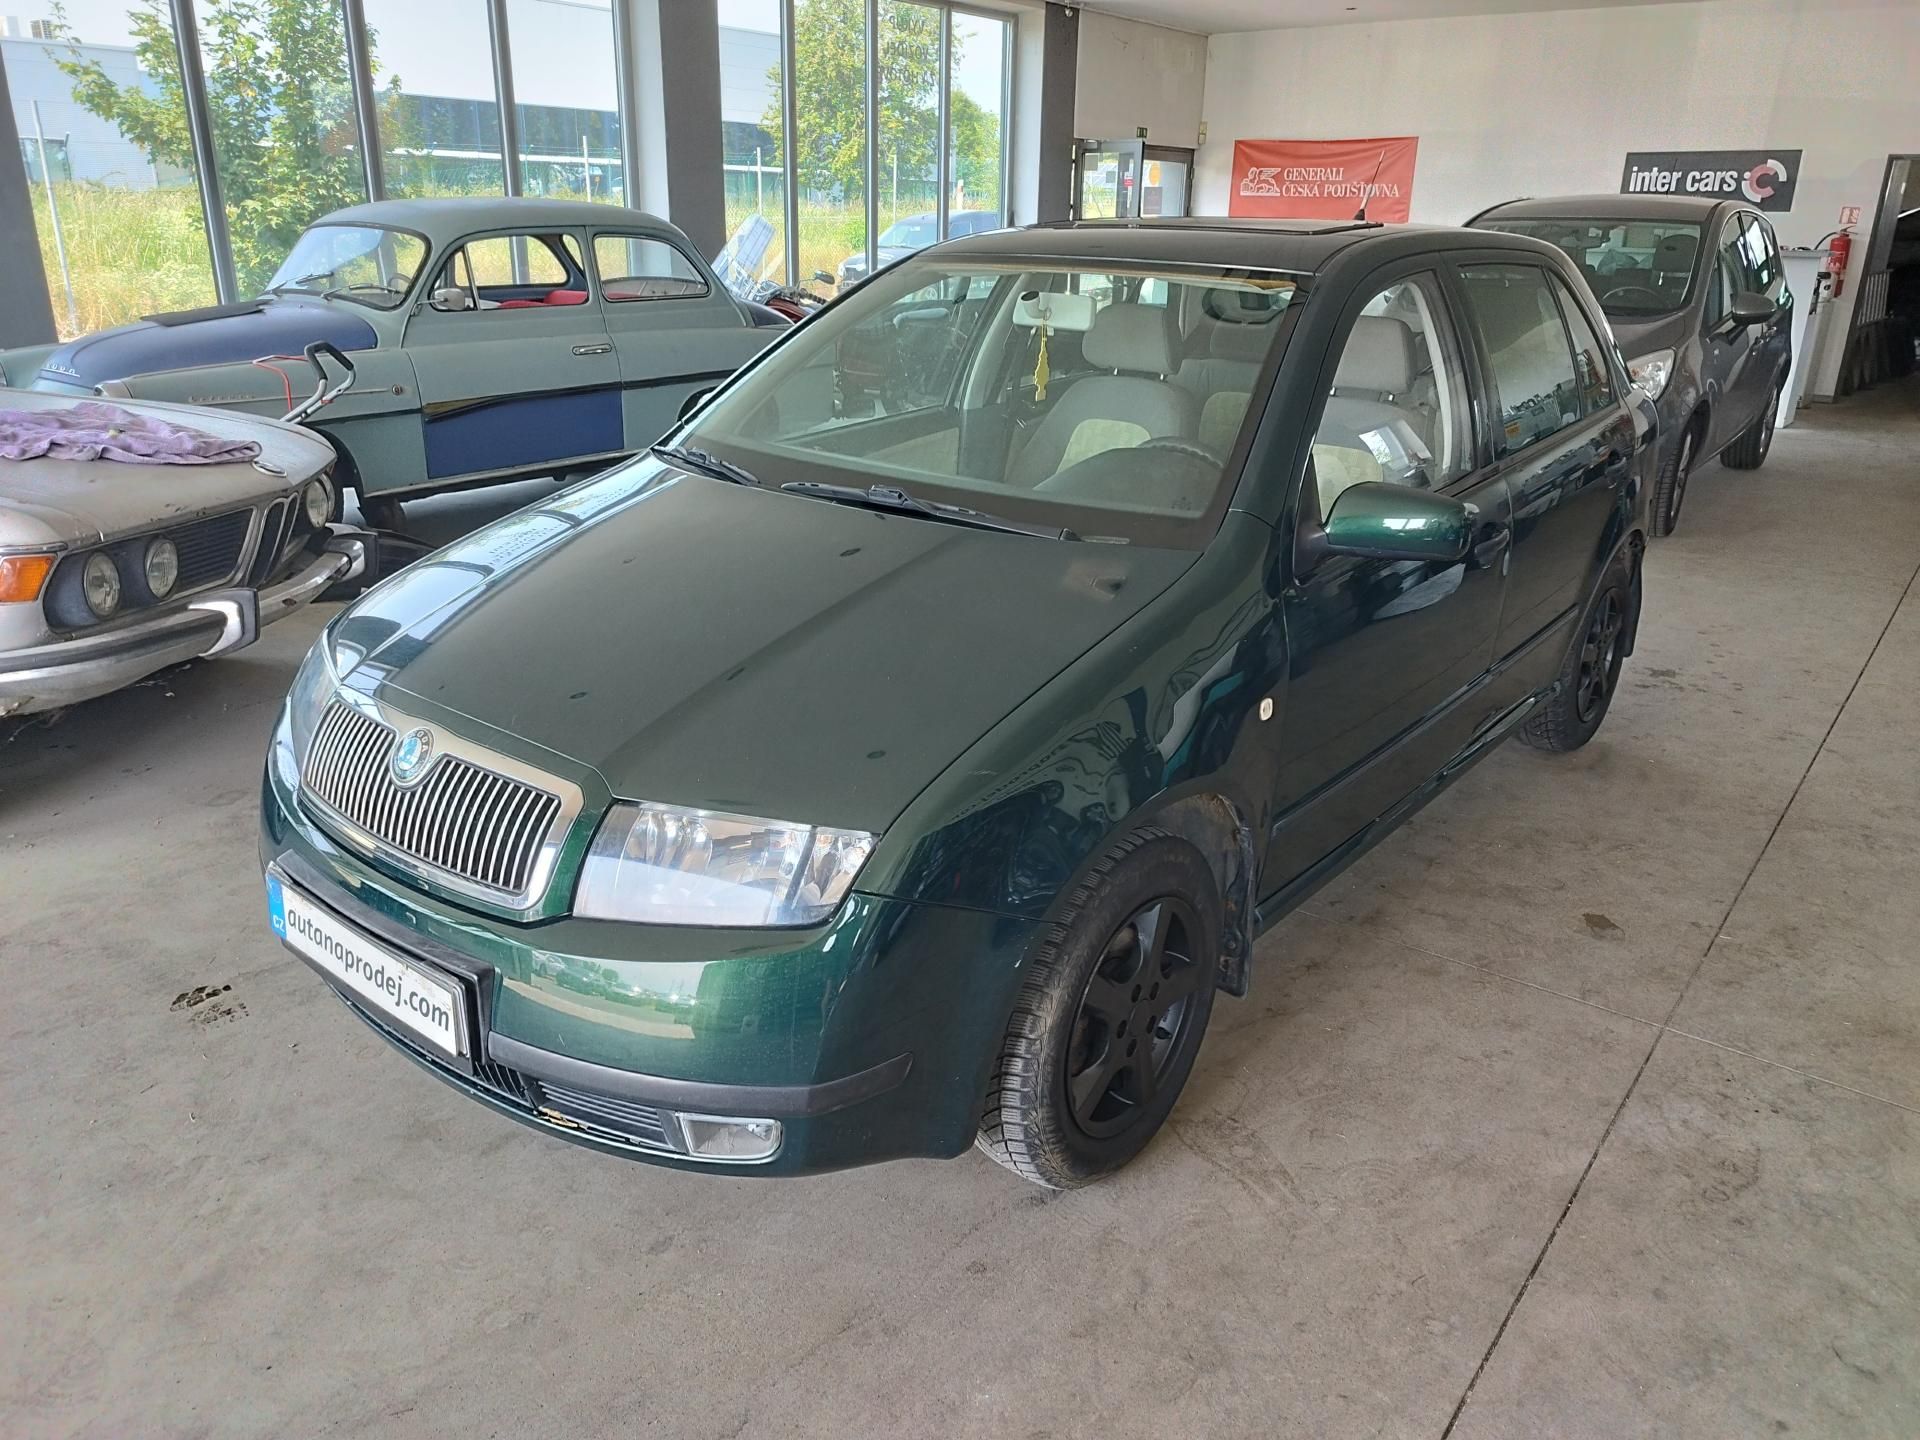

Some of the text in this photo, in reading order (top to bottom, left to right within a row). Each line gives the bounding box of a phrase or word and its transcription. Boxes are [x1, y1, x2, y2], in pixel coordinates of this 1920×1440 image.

[1284, 167, 1344, 181] GENERALI
[1628, 166, 1738, 192] inter cars
[1282, 181, 1399, 198] ČESKÁ POJIŠŤOVNA
[287, 909, 450, 1032] autanaprodej.com
